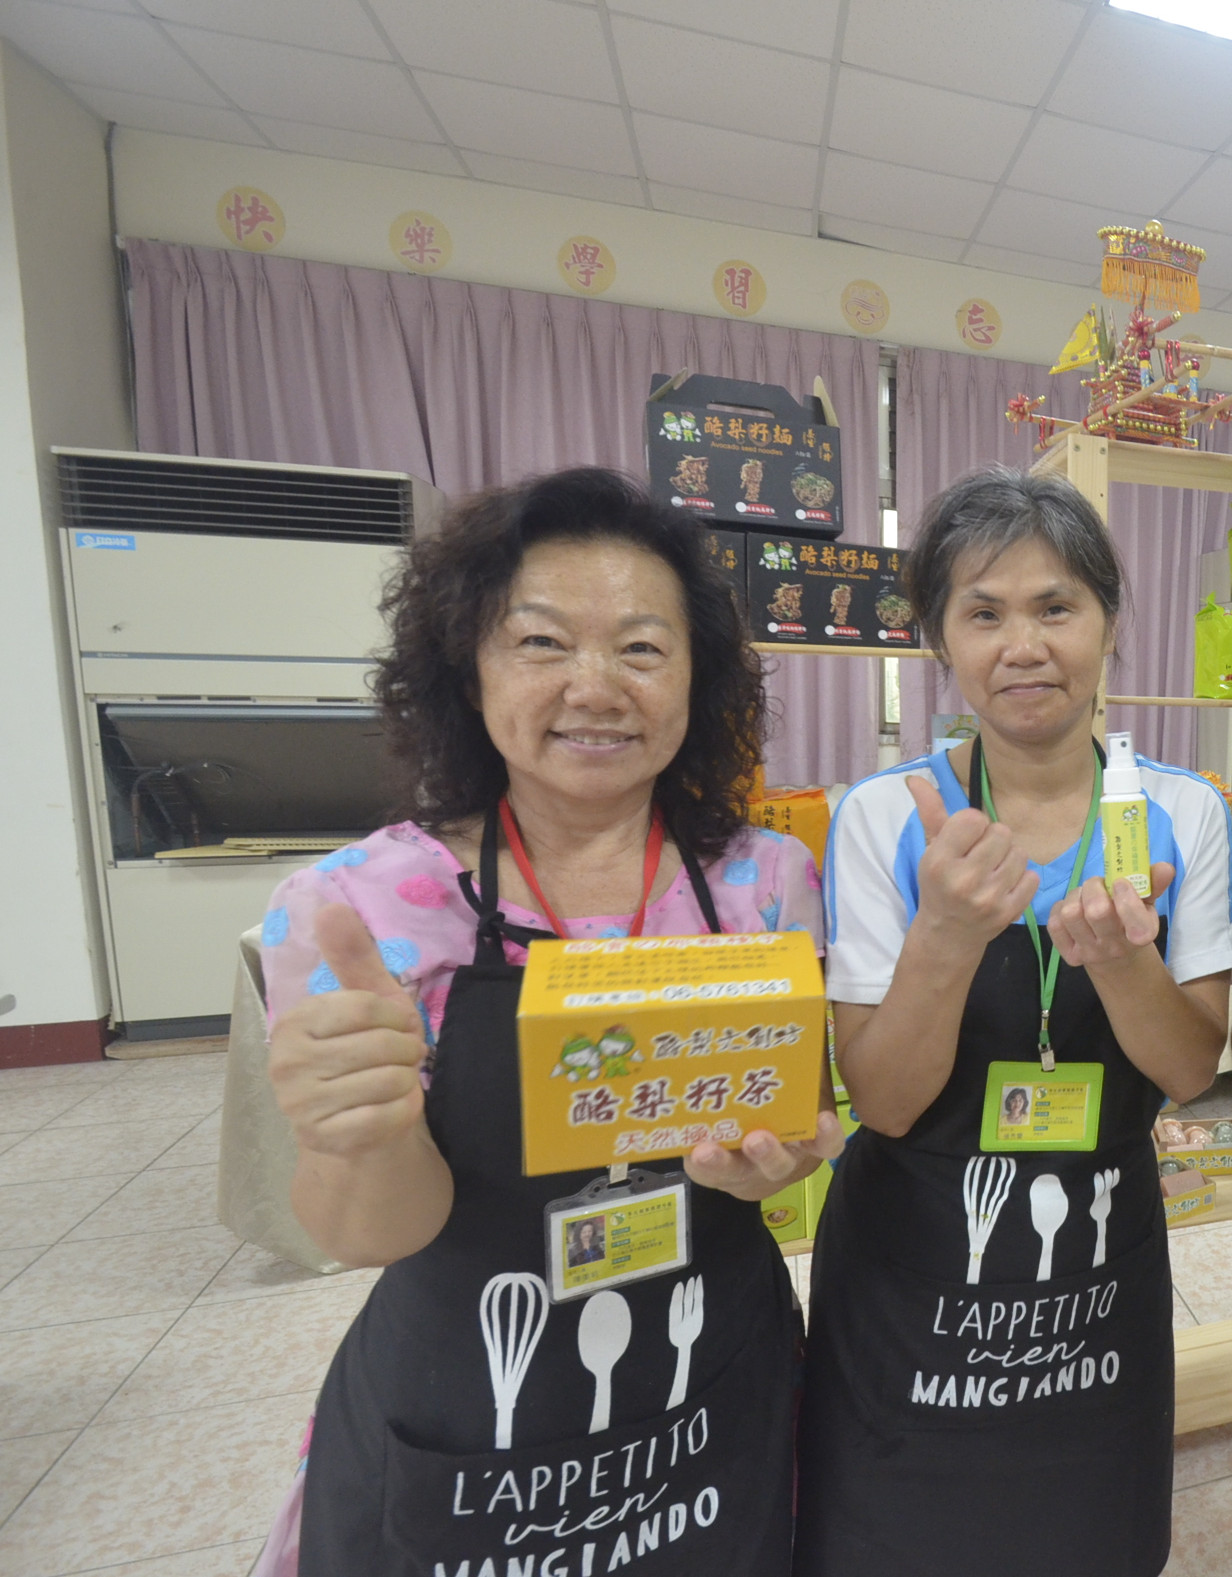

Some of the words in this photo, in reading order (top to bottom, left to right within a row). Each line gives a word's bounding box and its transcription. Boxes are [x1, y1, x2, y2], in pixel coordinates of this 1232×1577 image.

[758, 448, 784, 456] noodles
[571, 1067, 782, 1125] 酪梨籽茶
[933, 1281, 1117, 1340] L'APPETITO
[911, 1350, 1120, 1408] MANGIANDO
[967, 1340, 1085, 1368] vien
[453, 1407, 708, 1516] L'APPETITO
[504, 1482, 668, 1546] vien
